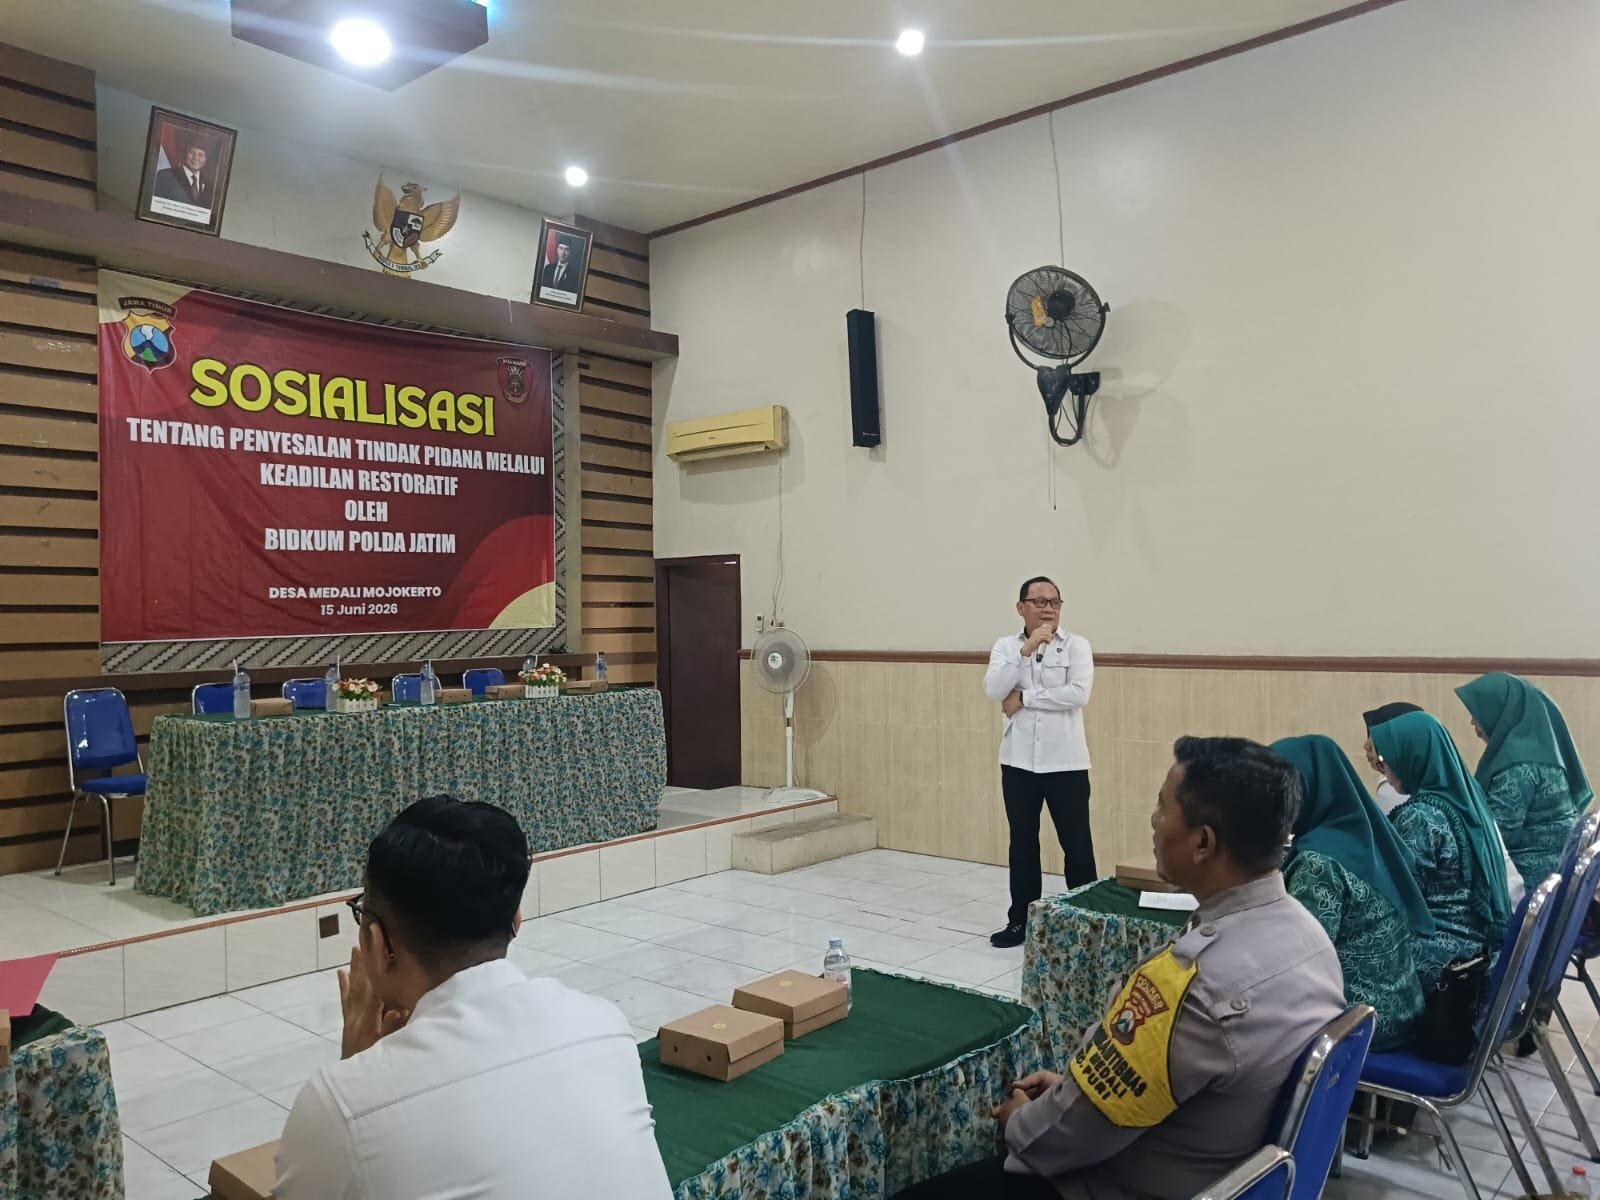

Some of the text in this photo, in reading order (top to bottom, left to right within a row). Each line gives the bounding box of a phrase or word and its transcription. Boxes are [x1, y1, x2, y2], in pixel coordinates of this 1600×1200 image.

[147, 302, 173, 314] TIMUR
[190, 358, 496, 437] SOSIALISASI
[126, 417, 545, 475] TENTANG PENYESALAN TINDAK PIDANA MELALUI
[260, 462, 459, 496] KEADILAN RESTORATIF
[344, 500, 389, 522] OLEH
[264, 527, 456, 554] BIDKUM POLDA JATIM
[269, 586, 442, 599] DESA MEDALI MOJOKERTO
[320, 602, 398, 615] 15 Juni 2026
[1082, 1065, 1111, 1100] PURI
[1089, 1052, 1127, 1098] MEDALI
